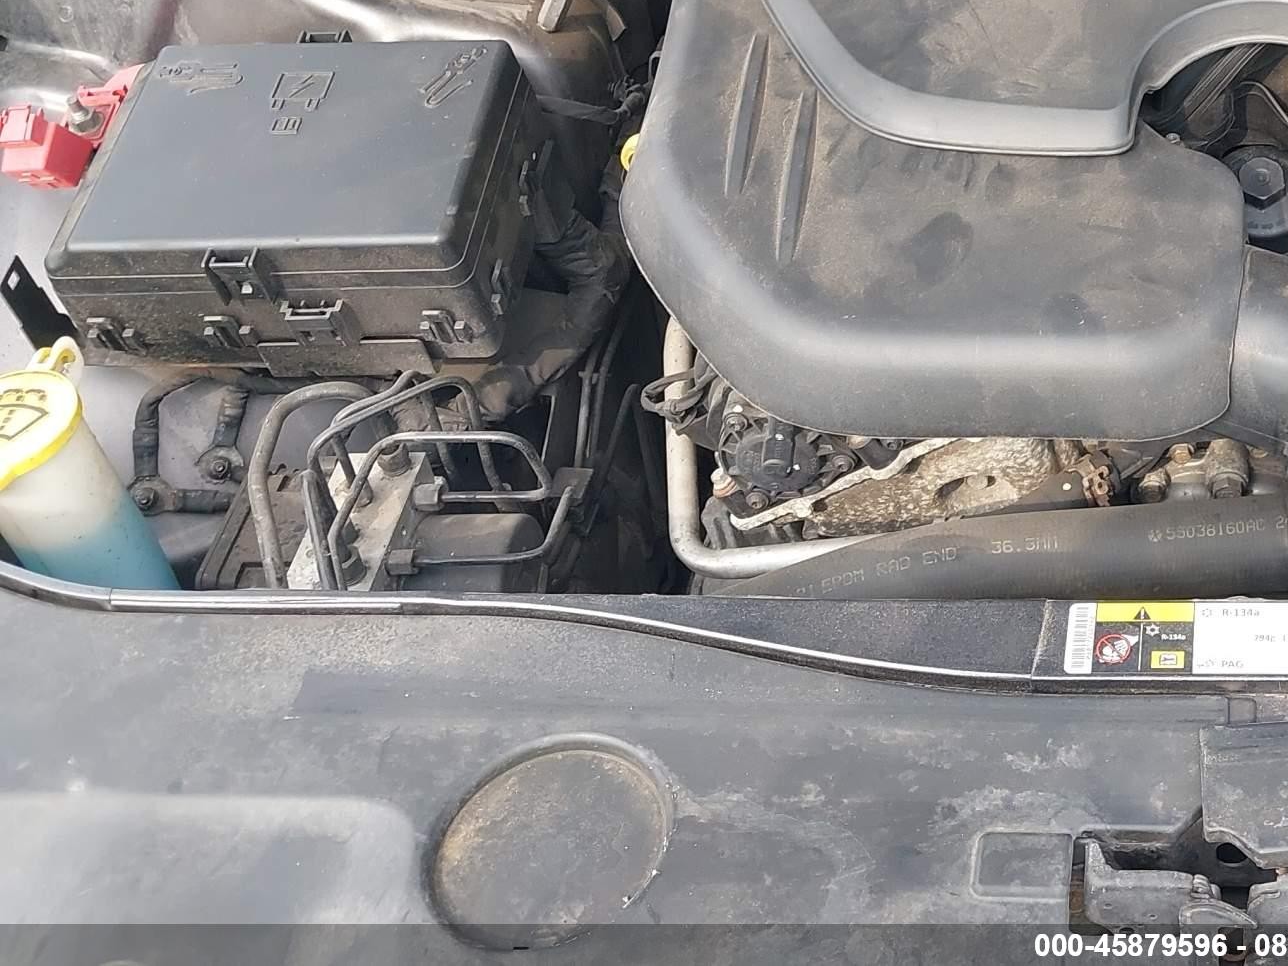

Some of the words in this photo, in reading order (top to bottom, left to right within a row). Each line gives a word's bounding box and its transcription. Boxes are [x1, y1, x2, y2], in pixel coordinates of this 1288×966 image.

[876, 556, 912, 577] RAD
[922, 545, 959, 566] END
[1221, 608, 1260, 617] R-134a
[1221, 660, 1245, 669] PAG
